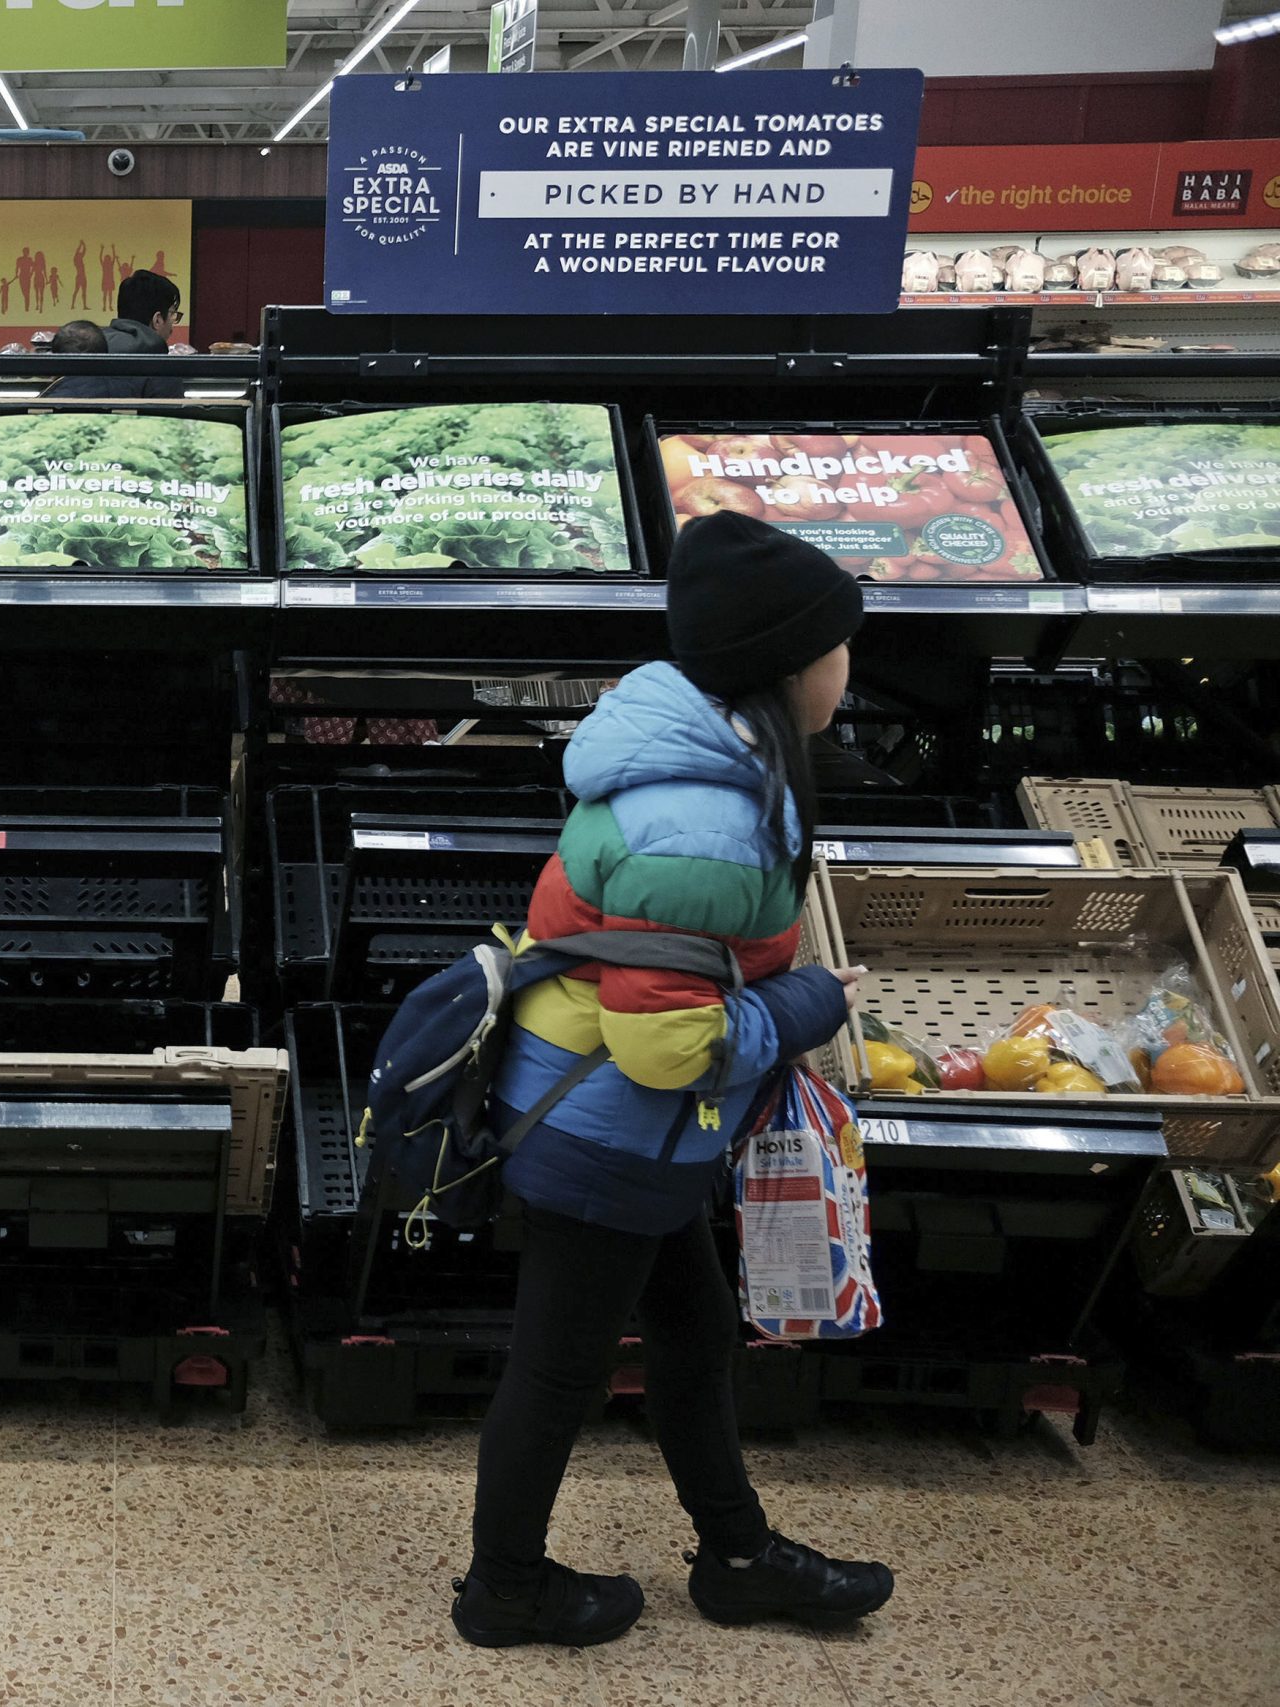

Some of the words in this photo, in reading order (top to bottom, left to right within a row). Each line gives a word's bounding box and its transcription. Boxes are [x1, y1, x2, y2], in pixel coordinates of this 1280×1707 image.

[499, 117, 549, 135] OUR
[557, 117, 635, 134] EXTRA
[645, 115, 745, 133] SPECIAL
[754, 113, 884, 133] TOMATOES
[371, 146, 427, 164] PASSION
[546, 141, 597, 158] ARE
[602, 140, 659, 158] VINE
[668, 139, 768, 157] RIPENED
[779, 138, 832, 156] AND
[376, 163, 409, 174] ASDA
[353, 177, 430, 195] EXTRA
[1184, 174, 1241, 187] HAJI
[545, 184, 665, 206] PICKED
[678, 184, 720, 205] BY
[733, 183, 827, 205] HAND
[959, 185, 998, 206] the
[1000, 184, 1051, 209] right
[1057, 183, 1132, 205] choice
[1182, 188, 1241, 201] BABA
[342, 196, 440, 214] SPECIAL
[354, 225, 375, 241] FOR
[378, 225, 426, 245] QUALITY
[523, 234, 554, 250] AT
[562, 233, 606, 249] THE
[615, 232, 721, 249] PERFECT
[728, 232, 783, 249] TIME
[791, 232, 840, 249] FOR
[534, 256, 550, 273] A
[558, 256, 710, 273] WONDERFUL
[716, 255, 826, 273] FLAVOUR
[43, 460, 73, 472] We
[79, 460, 122, 473] have
[408, 457, 440, 469] We
[445, 454, 490, 467] have
[687, 449, 970, 480] Handpicked
[1189, 461, 1224, 470] We
[1229, 460, 1276, 470] have
[14, 474, 153, 494] deliveries
[159, 481, 231, 503] daily
[300, 477, 375, 502] fresh
[381, 469, 525, 492] deliveries
[531, 469, 603, 492] daily
[755, 485, 801, 506] to
[807, 482, 899, 507] help
[1077, 477, 1164, 498] fresh
[1169, 472, 1280, 489] deliver
[19, 496, 94, 510] working
[98, 496, 141, 509] hard
[145, 500, 167, 510] to
[170, 500, 218, 517] bring
[314, 502, 348, 516] and
[353, 499, 383, 511] are
[389, 493, 465, 509] working
[470, 491, 513, 504] hard
[518, 492, 538, 503] to
[542, 492, 593, 507] bring
[1103, 495, 1142, 509] and
[1146, 494, 1179, 504] are
[1184, 488, 1268, 501] working
[1132, 508, 1170, 520] you
[1175, 503, 1231, 514] more
[1237, 500, 1257, 511] of
[4, 513, 51, 524] more
[57, 511, 77, 523] of
[81, 513, 111, 524] our
[117, 513, 200, 531] products
[334, 517, 372, 533] you
[375, 513, 424, 526] more
[429, 510, 450, 522] of
[454, 510, 485, 521] our
[491, 509, 576, 524] products
[825, 536, 892, 544] Greengrocer
[835, 528, 876, 536] looking
[756, 1138, 803, 1154] HOVIS
